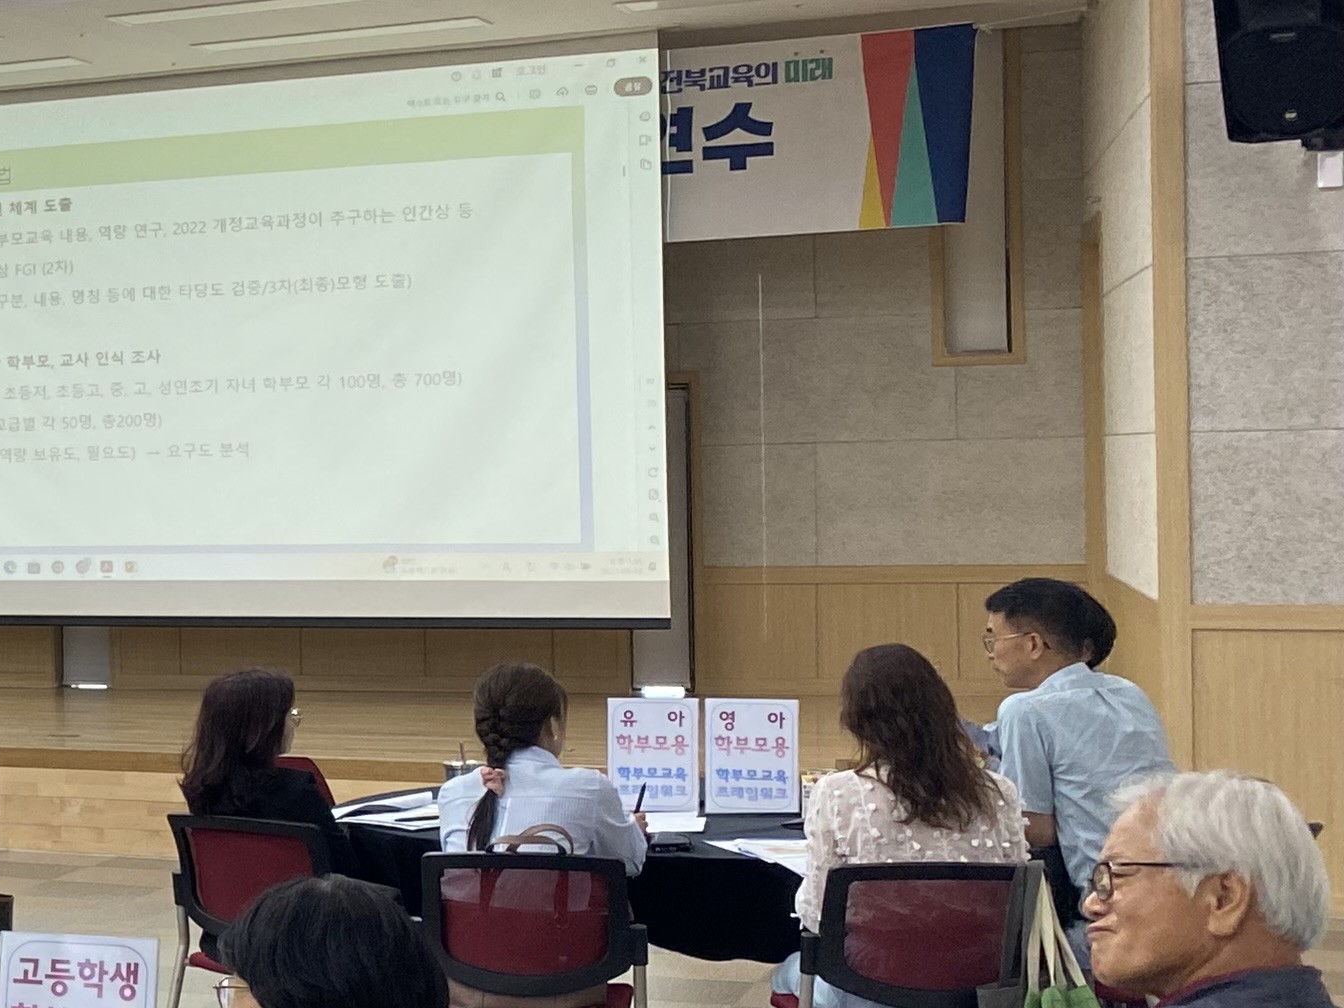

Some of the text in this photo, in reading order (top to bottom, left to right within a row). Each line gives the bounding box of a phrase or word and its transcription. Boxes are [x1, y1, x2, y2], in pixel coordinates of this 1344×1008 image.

[662, 56, 834, 94] 전북교육의 미래
[8, 199, 38, 216] 체계
[43, 197, 73, 213] 도출
[98, 223, 128, 241] 역량
[171, 220, 207, 237] 2022
[211, 210, 324, 235] 개정교육과정이
[401, 203, 451, 223] 인간상
[14, 261, 38, 278] FGI
[142, 284, 172, 302] 대한
[59, 351, 90, 369] 교사
[95, 350, 126, 367] 인식
[130, 348, 162, 365] 조사
[262, 375, 312, 393] 학부모
[620, 709, 686, 728] 유 아
[719, 710, 786, 731] 영 아
[615, 733, 690, 756] 학부모용
[714, 734, 790, 759] 학부모용
[617, 766, 689, 782] 학부모교육
[715, 767, 789, 785] 학부모교육
[715, 786, 789, 802] 프레임워크
[13, 957, 140, 1002] 고등학생
